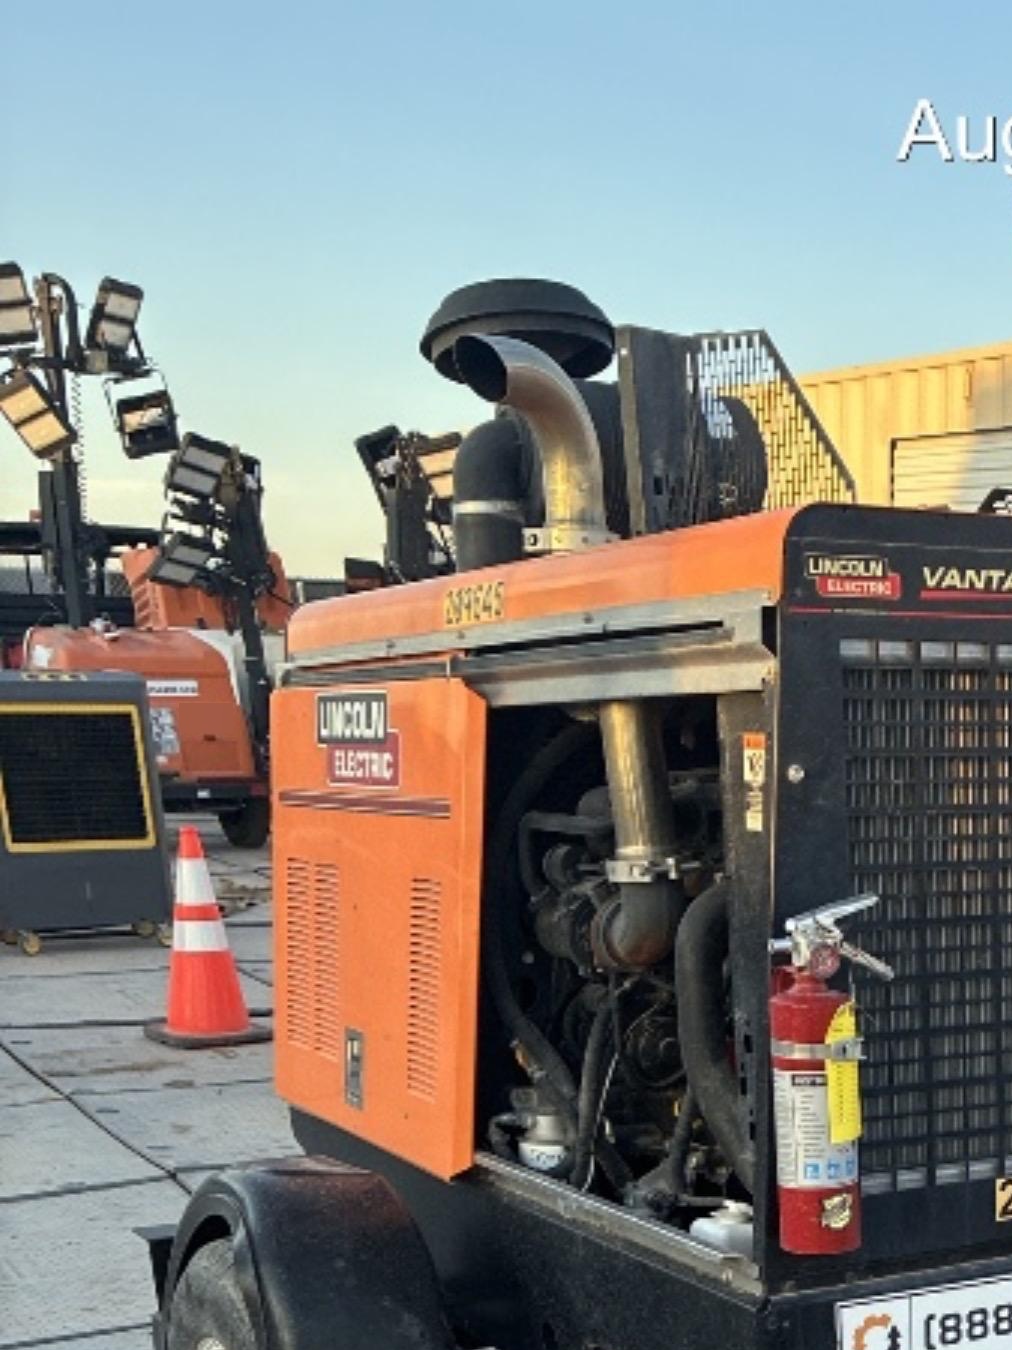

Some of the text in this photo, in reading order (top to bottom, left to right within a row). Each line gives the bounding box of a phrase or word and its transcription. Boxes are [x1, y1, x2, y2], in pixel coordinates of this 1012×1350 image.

[809, 557, 883, 577] LINCOLN
[826, 578, 893, 595] ELECTRIC
[319, 701, 385, 740] LINCOLN
[334, 748, 394, 780] ELECTRIC
